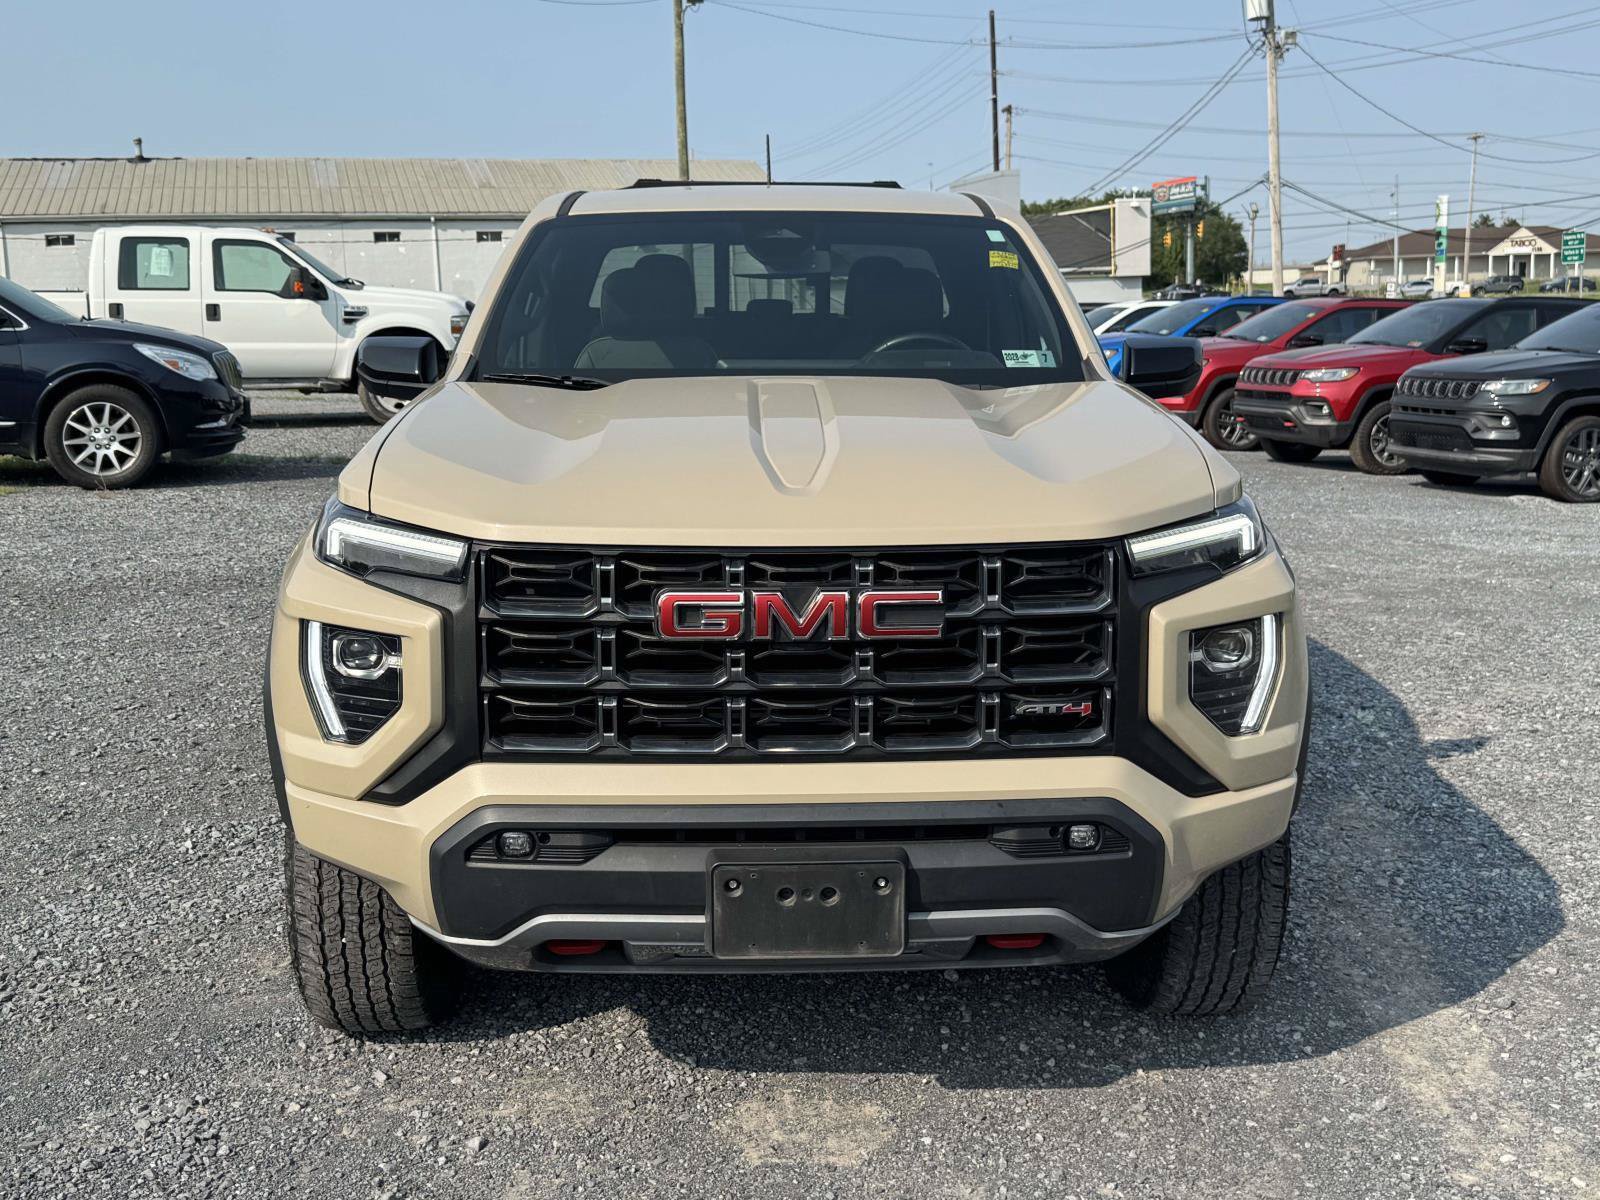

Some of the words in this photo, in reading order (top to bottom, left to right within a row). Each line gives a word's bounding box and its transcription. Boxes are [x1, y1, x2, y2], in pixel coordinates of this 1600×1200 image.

[1511, 239, 1537, 247] TABOO
[656, 590, 944, 641] GMC
[1015, 702, 1092, 717] AT4
